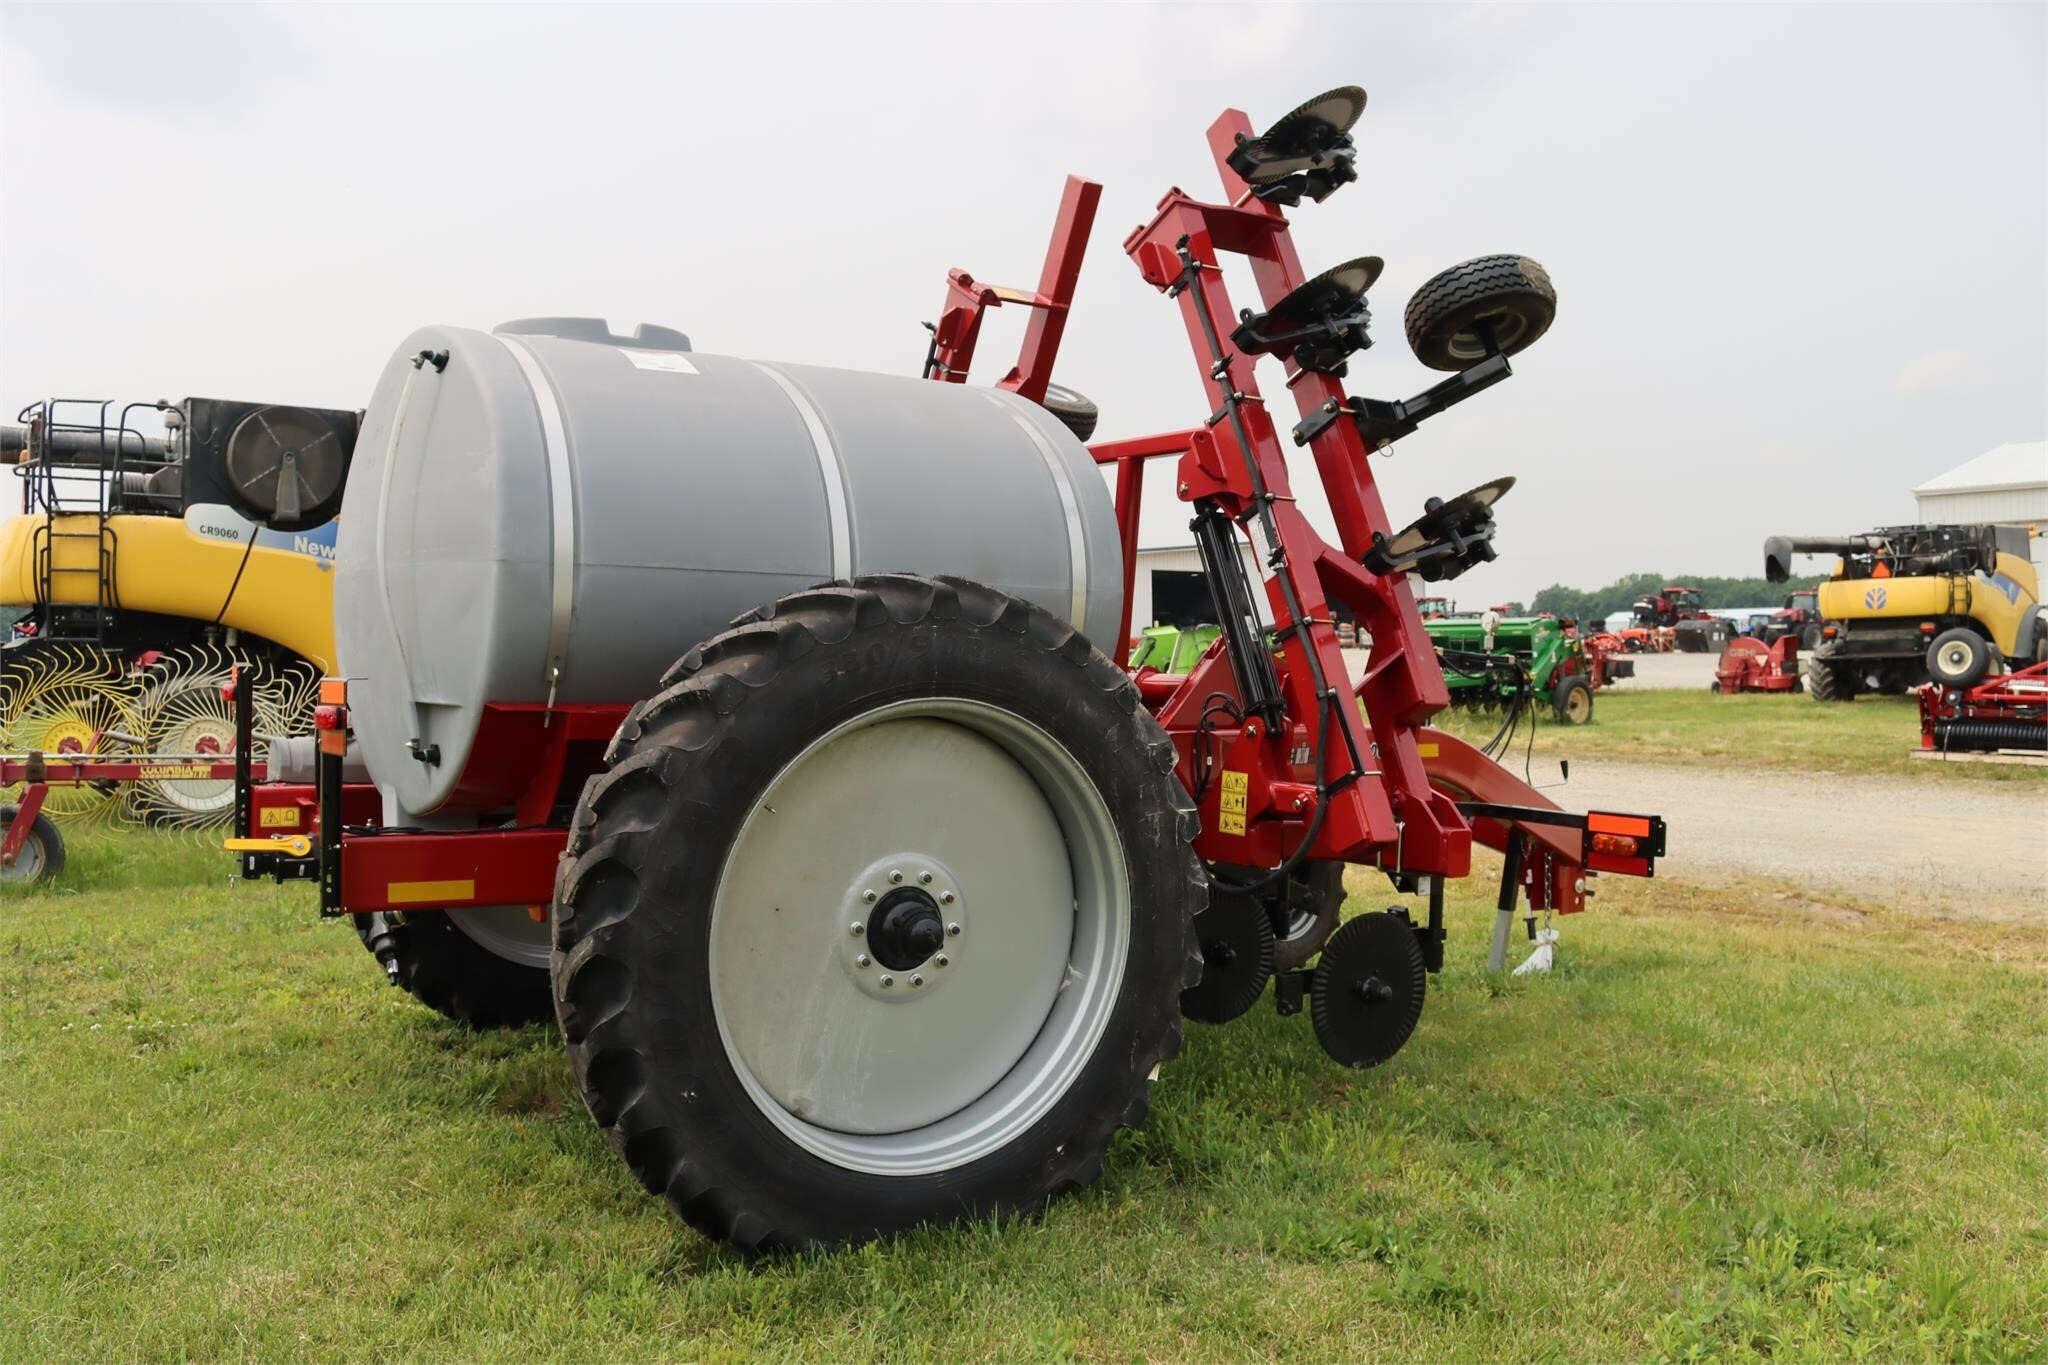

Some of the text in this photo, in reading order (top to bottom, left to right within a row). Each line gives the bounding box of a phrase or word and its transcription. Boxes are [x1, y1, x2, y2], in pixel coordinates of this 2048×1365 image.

[199, 524, 239, 540] CR9060
[293, 535, 336, 560] New
[139, 765, 194, 776] COLUMBIA
